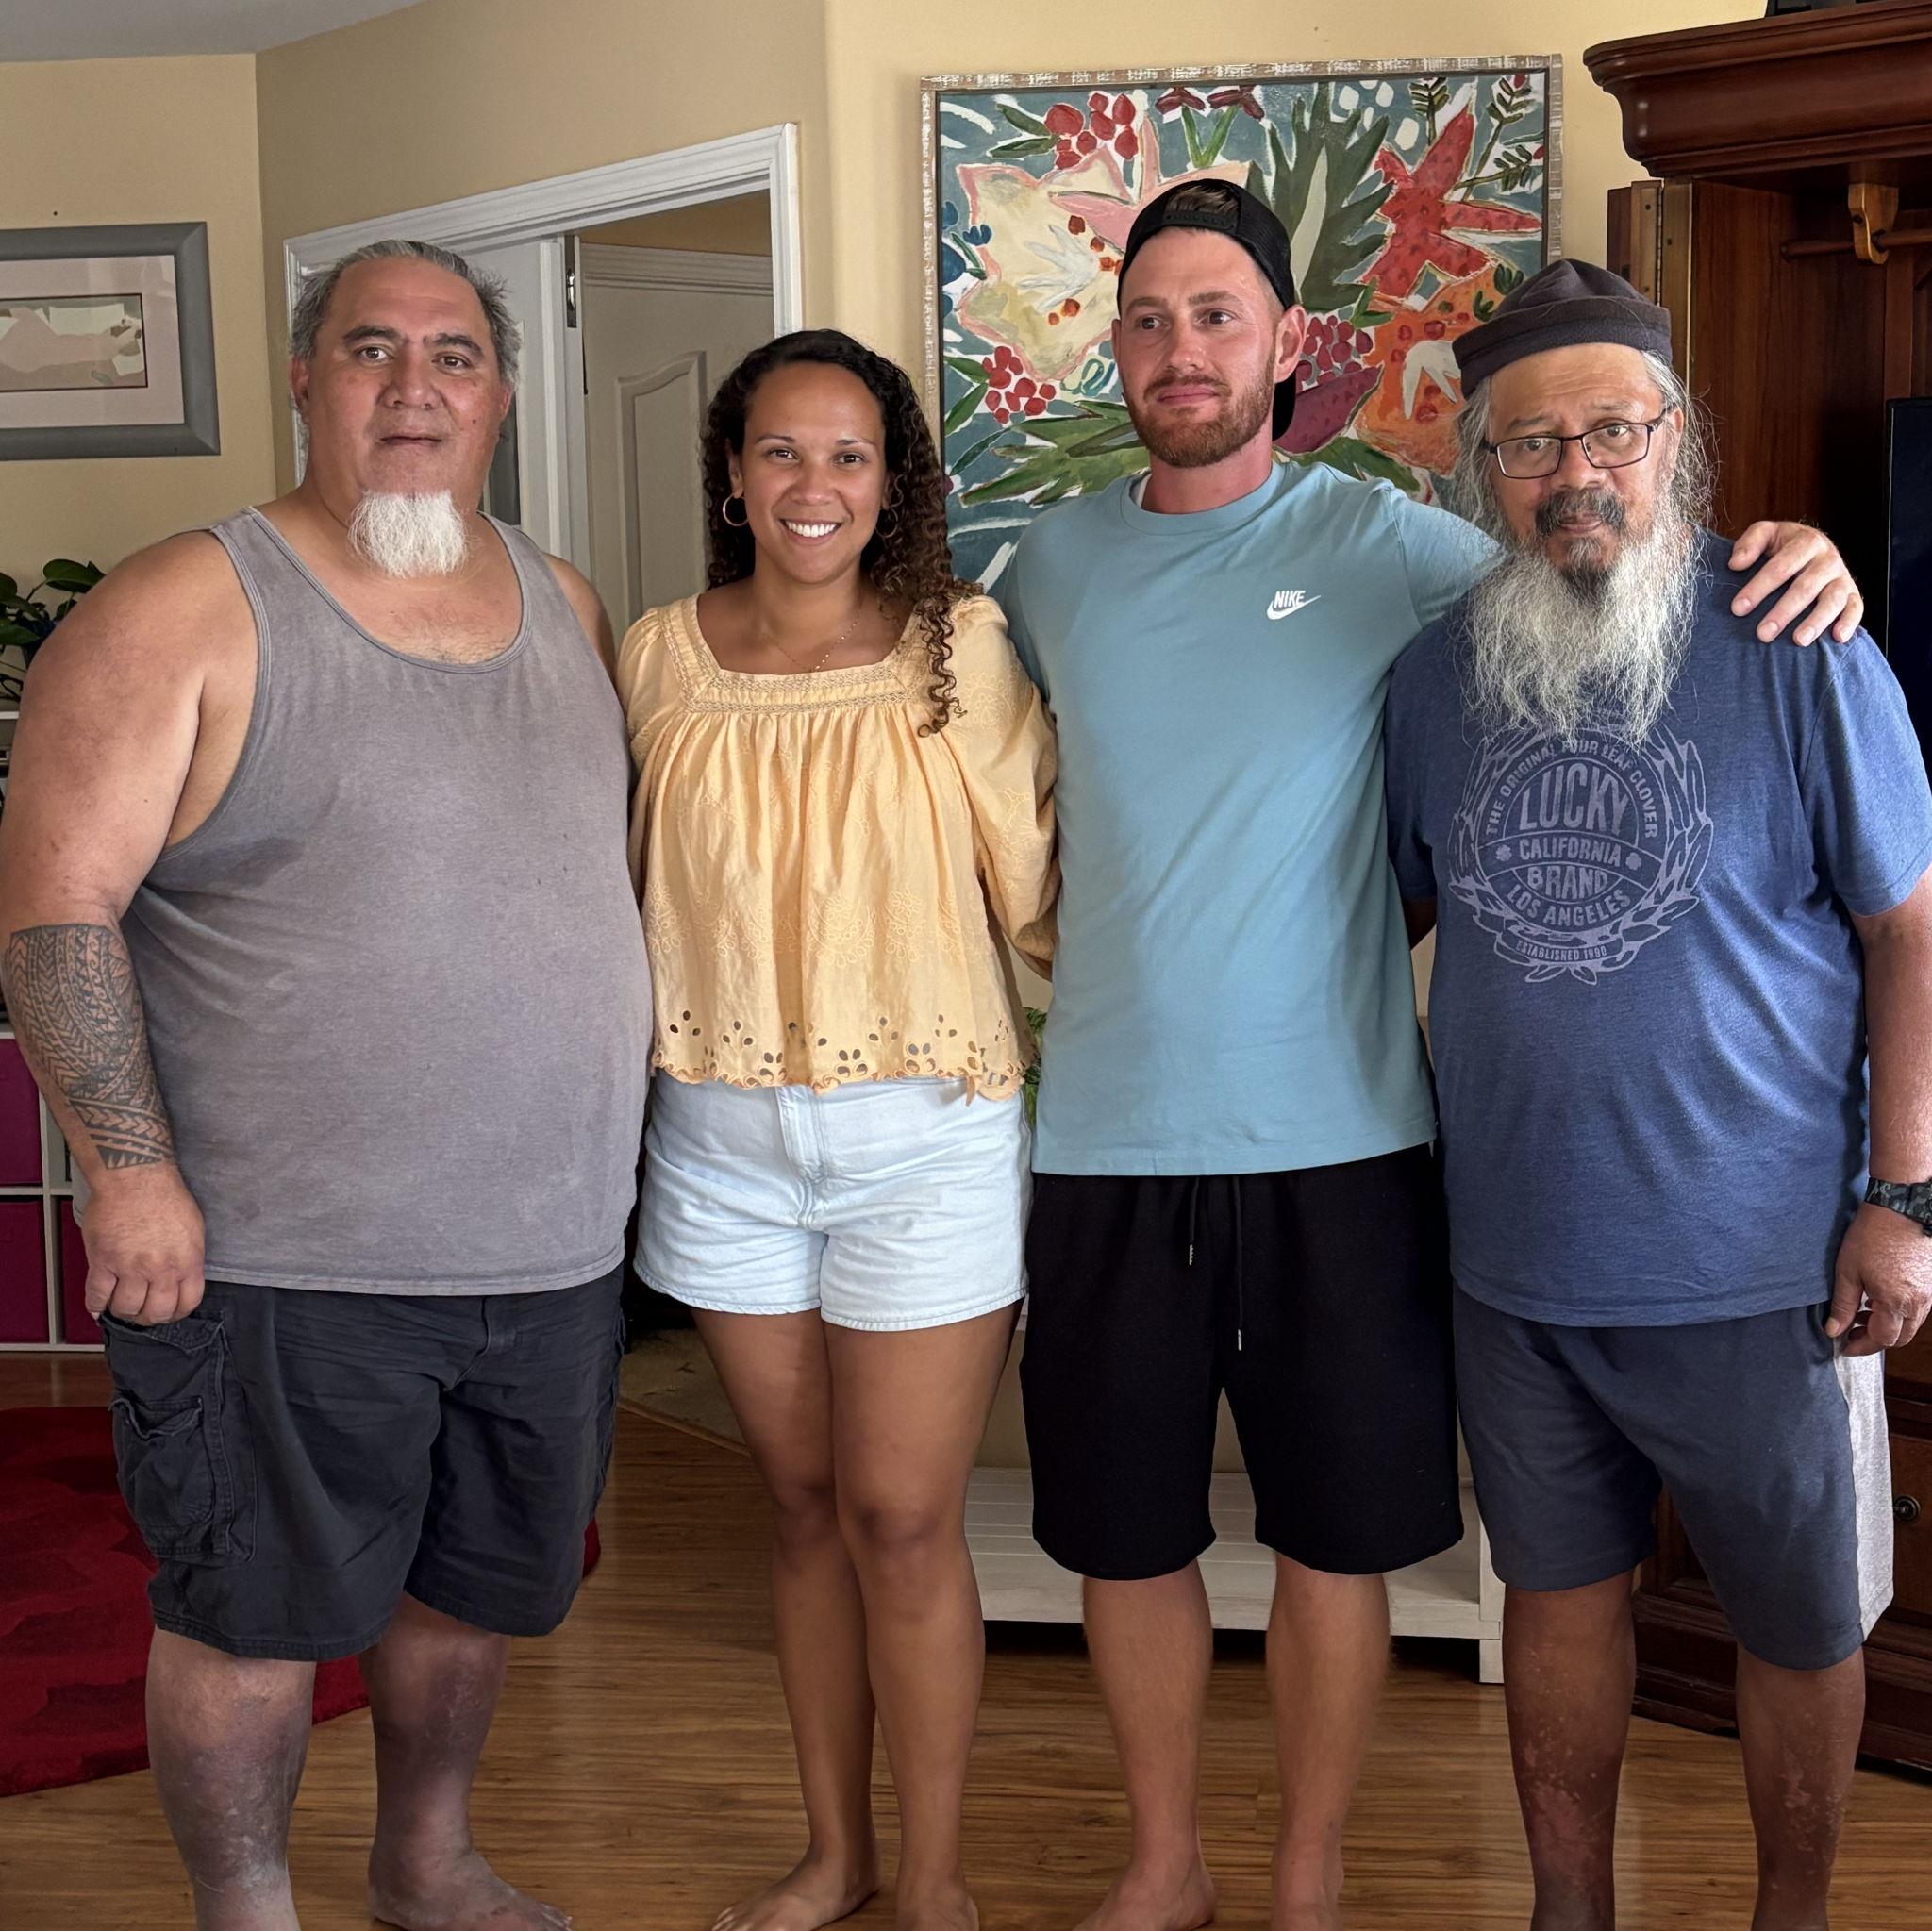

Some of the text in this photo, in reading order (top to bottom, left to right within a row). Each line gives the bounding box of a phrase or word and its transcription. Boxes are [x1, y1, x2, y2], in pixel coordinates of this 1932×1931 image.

[1273, 590, 1307, 608] NIKE
[1486, 739, 1658, 839] THE ORIGINAL FOUR LEAF CLOVER
[1519, 762, 1630, 836] LUCKY
[1519, 837, 1622, 867] CALIFORNIA
[1526, 865, 1609, 900] BRAND
[1507, 884, 1632, 928] LOS ANGELES
[1515, 940, 1580, 961] ESTABLISHED
